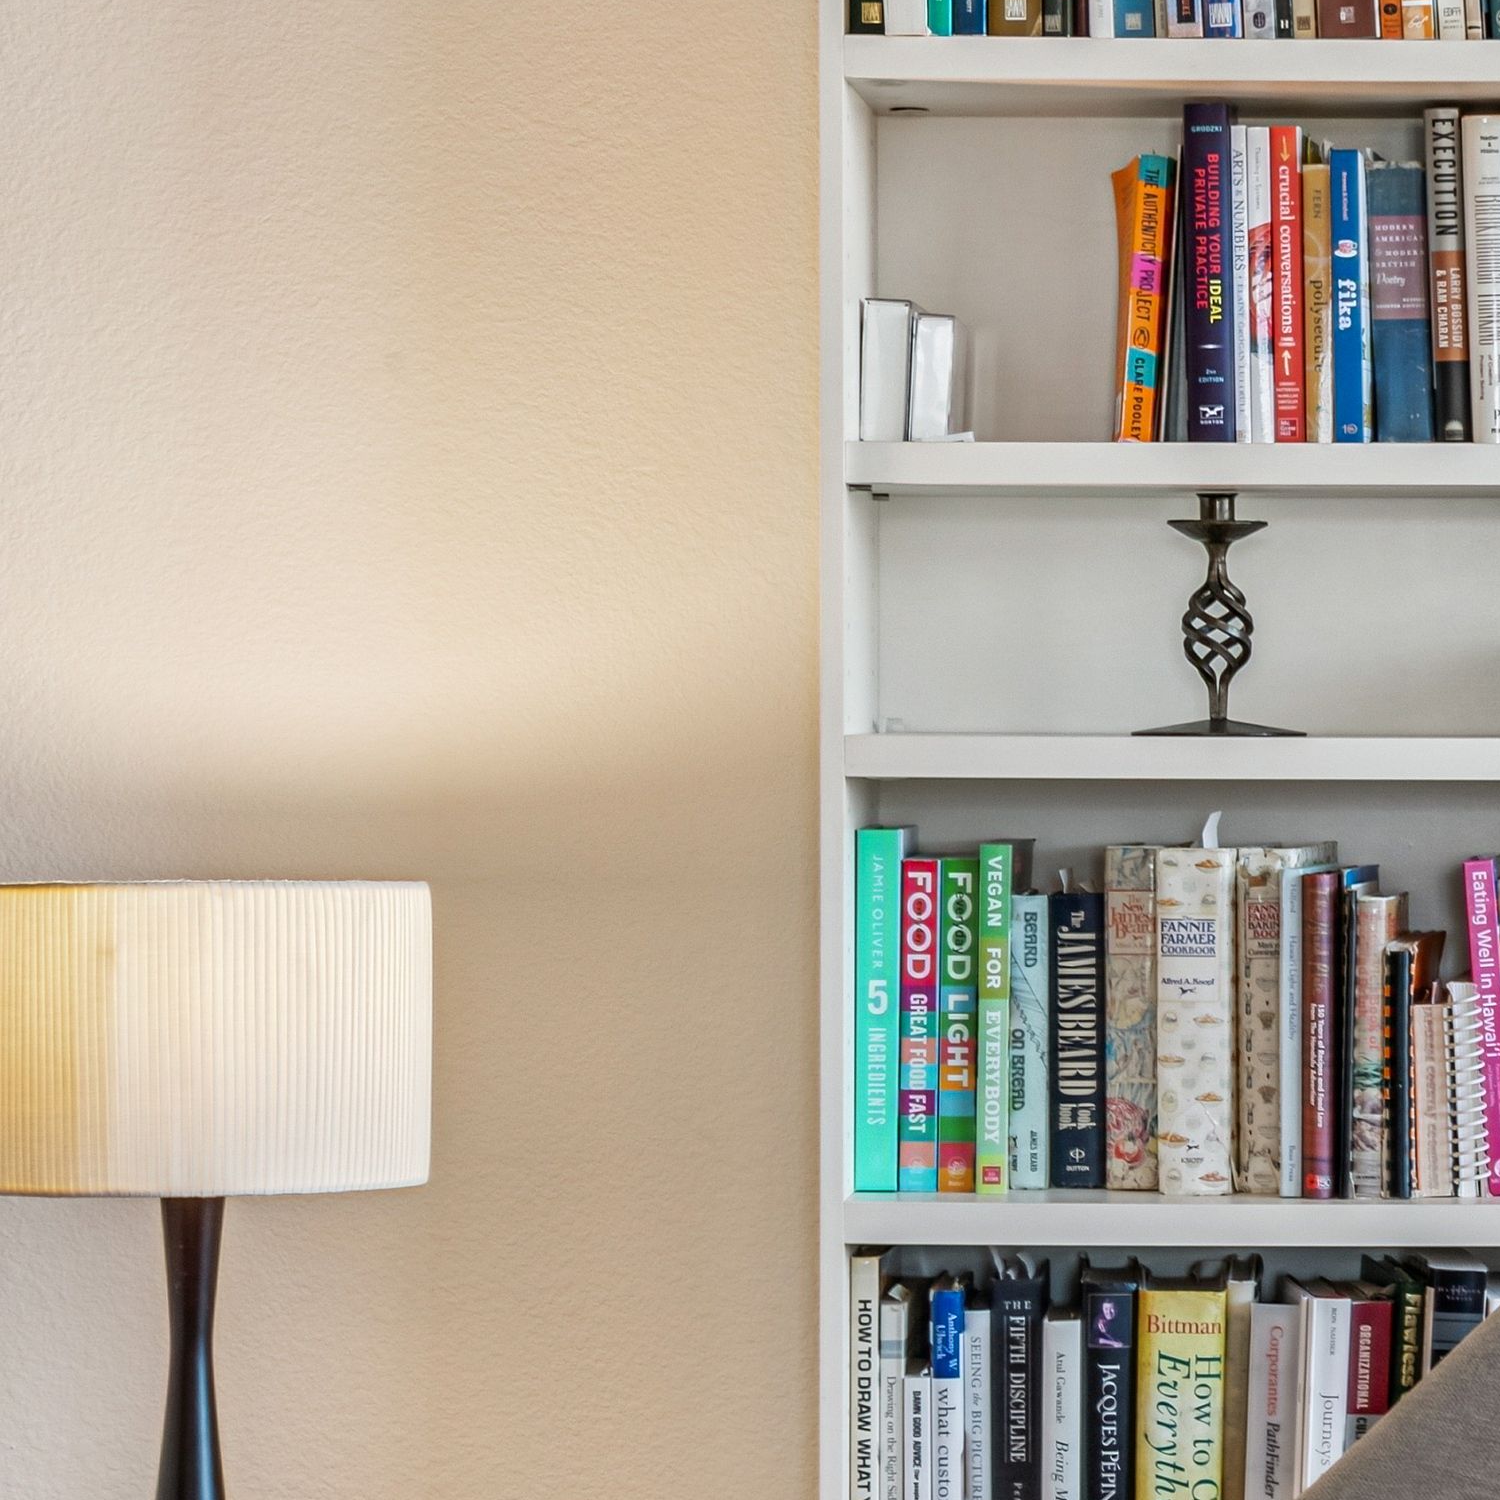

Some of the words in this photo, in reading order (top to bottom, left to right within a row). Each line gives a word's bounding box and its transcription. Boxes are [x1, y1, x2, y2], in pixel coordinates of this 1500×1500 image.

[1144, 169, 1159, 187] THE
[1194, 168, 1206, 230] PRIVATE
[1207, 153, 1220, 227] BUILDING
[1279, 166, 1293, 220] crucial
[1431, 118, 1458, 236] EXECUTION
[1141, 193, 1159, 264] AUTHENTICITY
[1208, 233, 1220, 273] YOUR
[1136, 270, 1152, 321] PROJECT
[1195, 236, 1207, 309] PRACTICE
[1279, 225, 1294, 334] conversations
[1209, 279, 1222, 323] IDEAL
[1338, 279, 1357, 330] fika
[1134, 358, 1145, 393] CLARE
[1132, 396, 1144, 441] POOLEY
[872, 854, 884, 900] JAMIE
[987, 855, 1001, 926] VEGAN
[1471, 871, 1490, 925] Eating
[872, 908, 884, 968] OLIVER
[907, 871, 932, 979] FOOD
[947, 872, 972, 979] FOOD
[1476, 930, 1494, 968] Well
[986, 948, 1000, 988] FOR
[1481, 973, 1496, 989] in
[868, 979, 887, 1014] 5
[909, 994, 928, 1044] GREAT
[947, 994, 969, 1087] LIGHT
[867, 1027, 886, 1125] INGREDIENTS
[909, 1048, 927, 1089] FOOD
[985, 1010, 1000, 1144] EVERYBODY
[909, 1094, 926, 1133] FAST
[858, 1299, 872, 1344] HOW
[1009, 1316, 1025, 1363] FIFTH
[1146, 1314, 1221, 1334] Bittman
[858, 1348, 871, 1371] TO
[1056, 1352, 1066, 1374] Atul
[857, 1376, 872, 1432] DRAW
[938, 1388, 955, 1436] what
[1055, 1378, 1065, 1424] Gawande
[1097, 1363, 1120, 1446] JACQUES
[1194, 1354, 1221, 1426] How
[1010, 1373, 1026, 1462] DISCIPLINE
[857, 1439, 871, 1492] WHAT
[1053, 1440, 1068, 1483] Being
[1195, 1439, 1215, 1466] to
